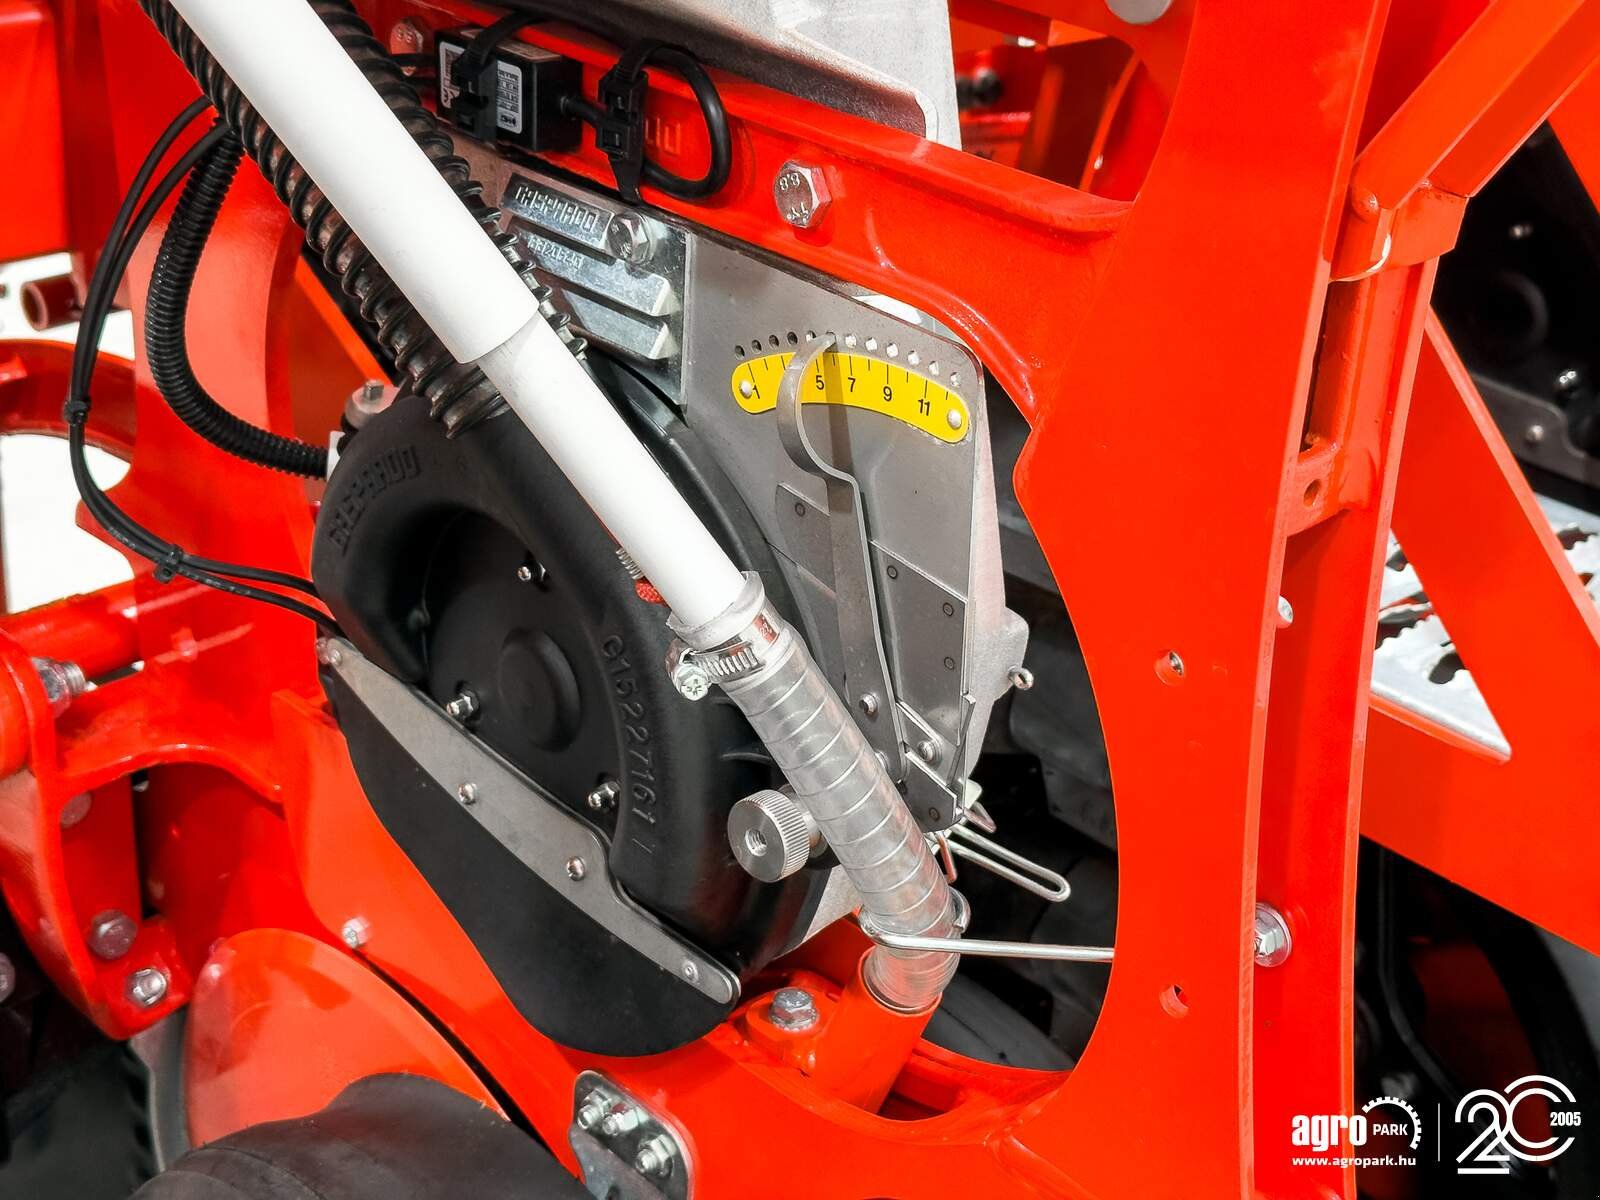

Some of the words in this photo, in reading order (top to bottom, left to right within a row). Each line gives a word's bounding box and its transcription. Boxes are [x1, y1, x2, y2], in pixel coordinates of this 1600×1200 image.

[515, 186, 598, 233] GASPARDO
[815, 375, 825, 391] 5
[847, 377, 856, 393] 7
[883, 386, 893, 402] 9
[917, 399, 931, 416] 11
